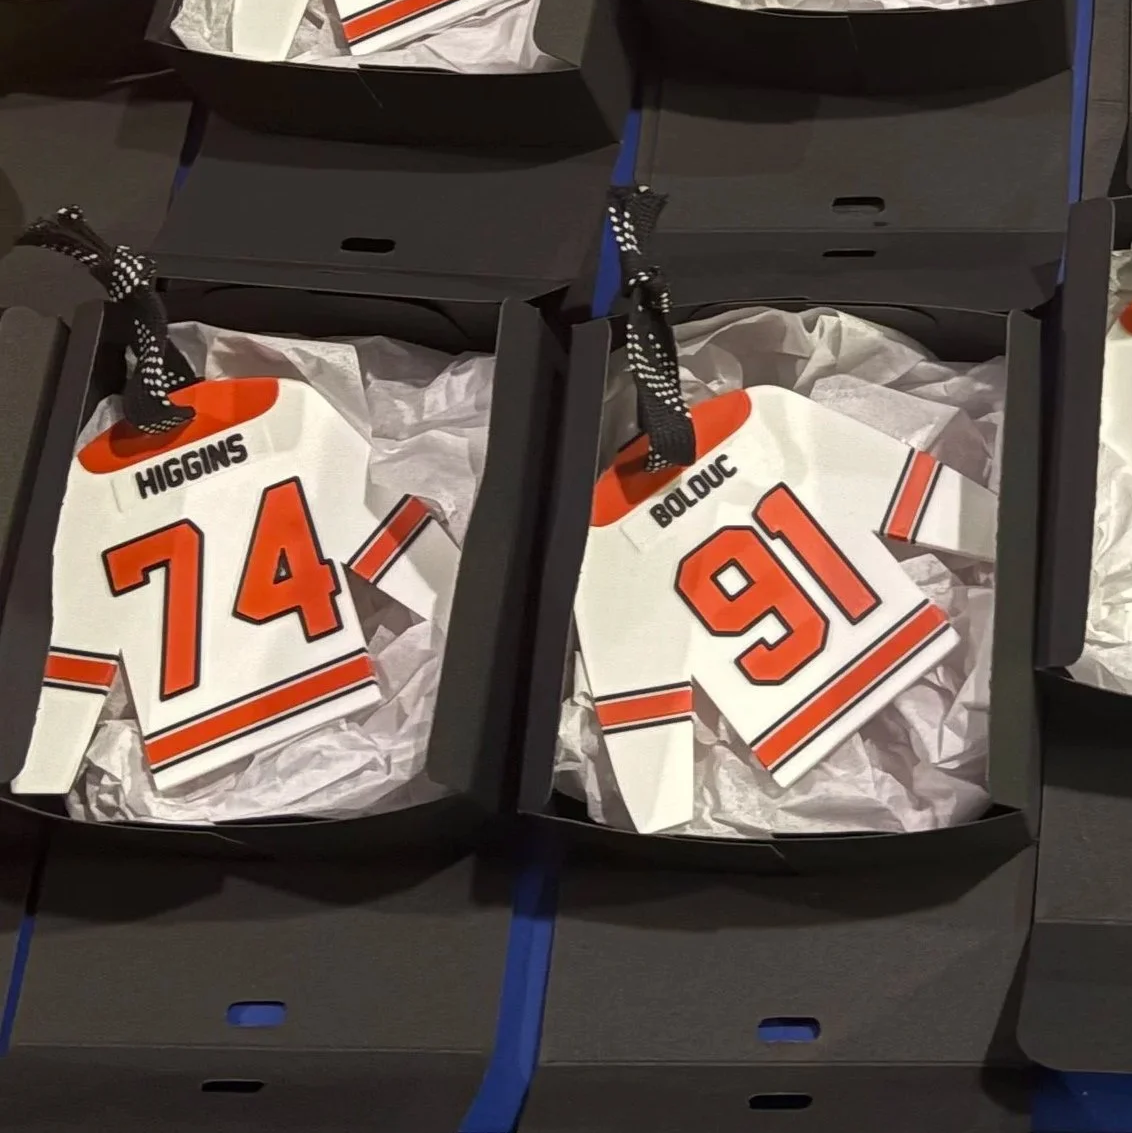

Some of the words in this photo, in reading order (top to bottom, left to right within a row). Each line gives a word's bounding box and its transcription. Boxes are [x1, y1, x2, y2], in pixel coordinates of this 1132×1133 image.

[135, 434, 249, 500] HIGGINS
[648, 454, 738, 529] BOLDUC
[101, 476, 345, 701] 74
[674, 482, 881, 686] 91
